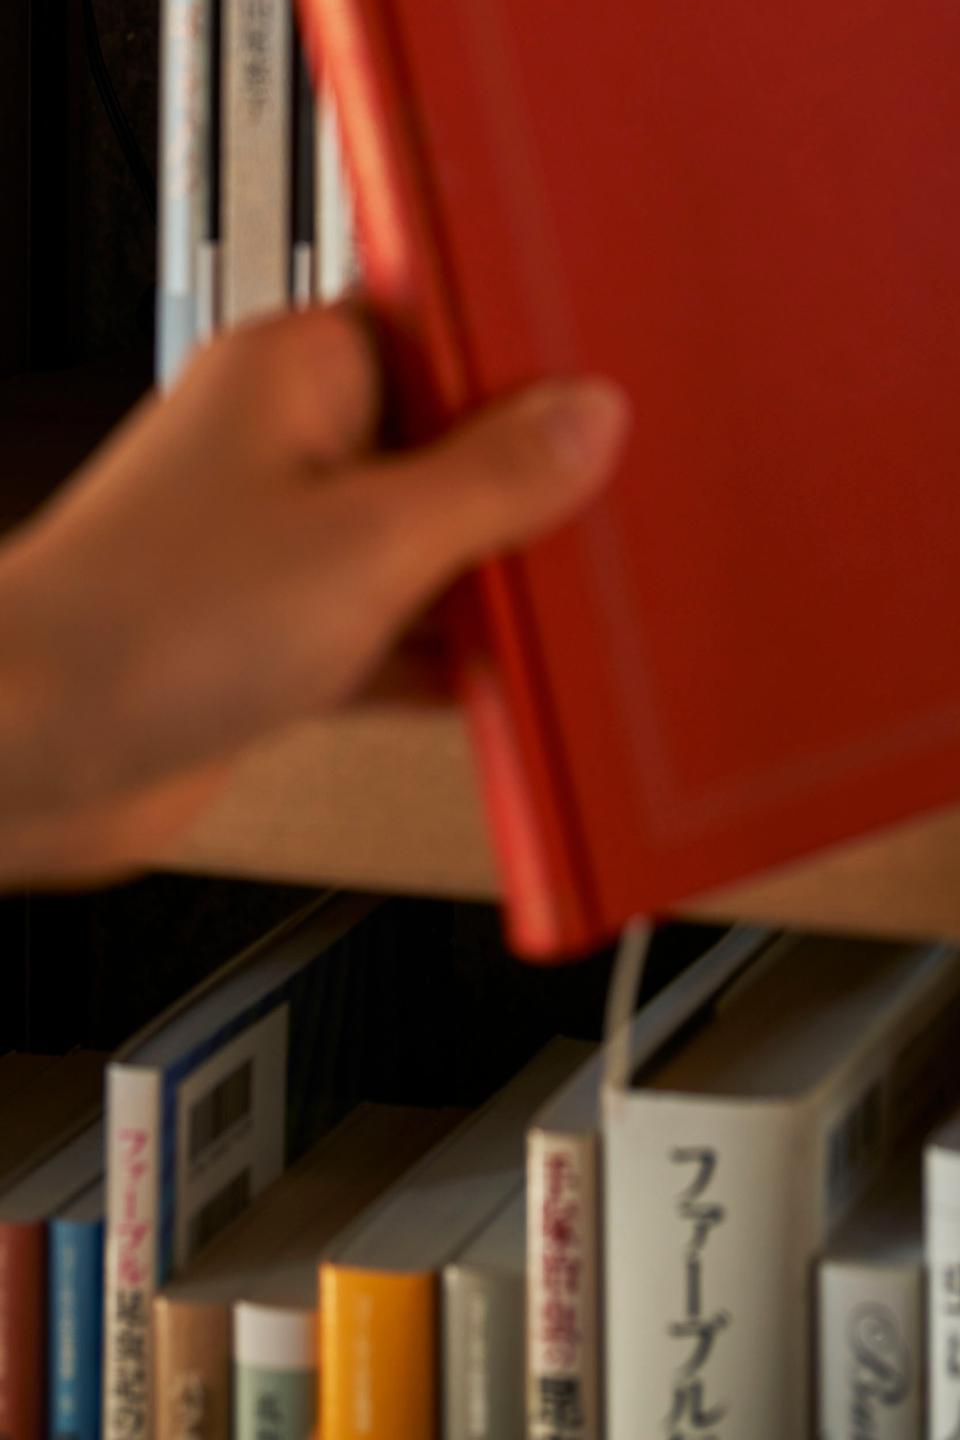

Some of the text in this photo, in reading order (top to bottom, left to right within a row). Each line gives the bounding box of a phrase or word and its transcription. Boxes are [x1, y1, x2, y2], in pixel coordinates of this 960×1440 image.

[664, 1146, 731, 1440] ファーブル
